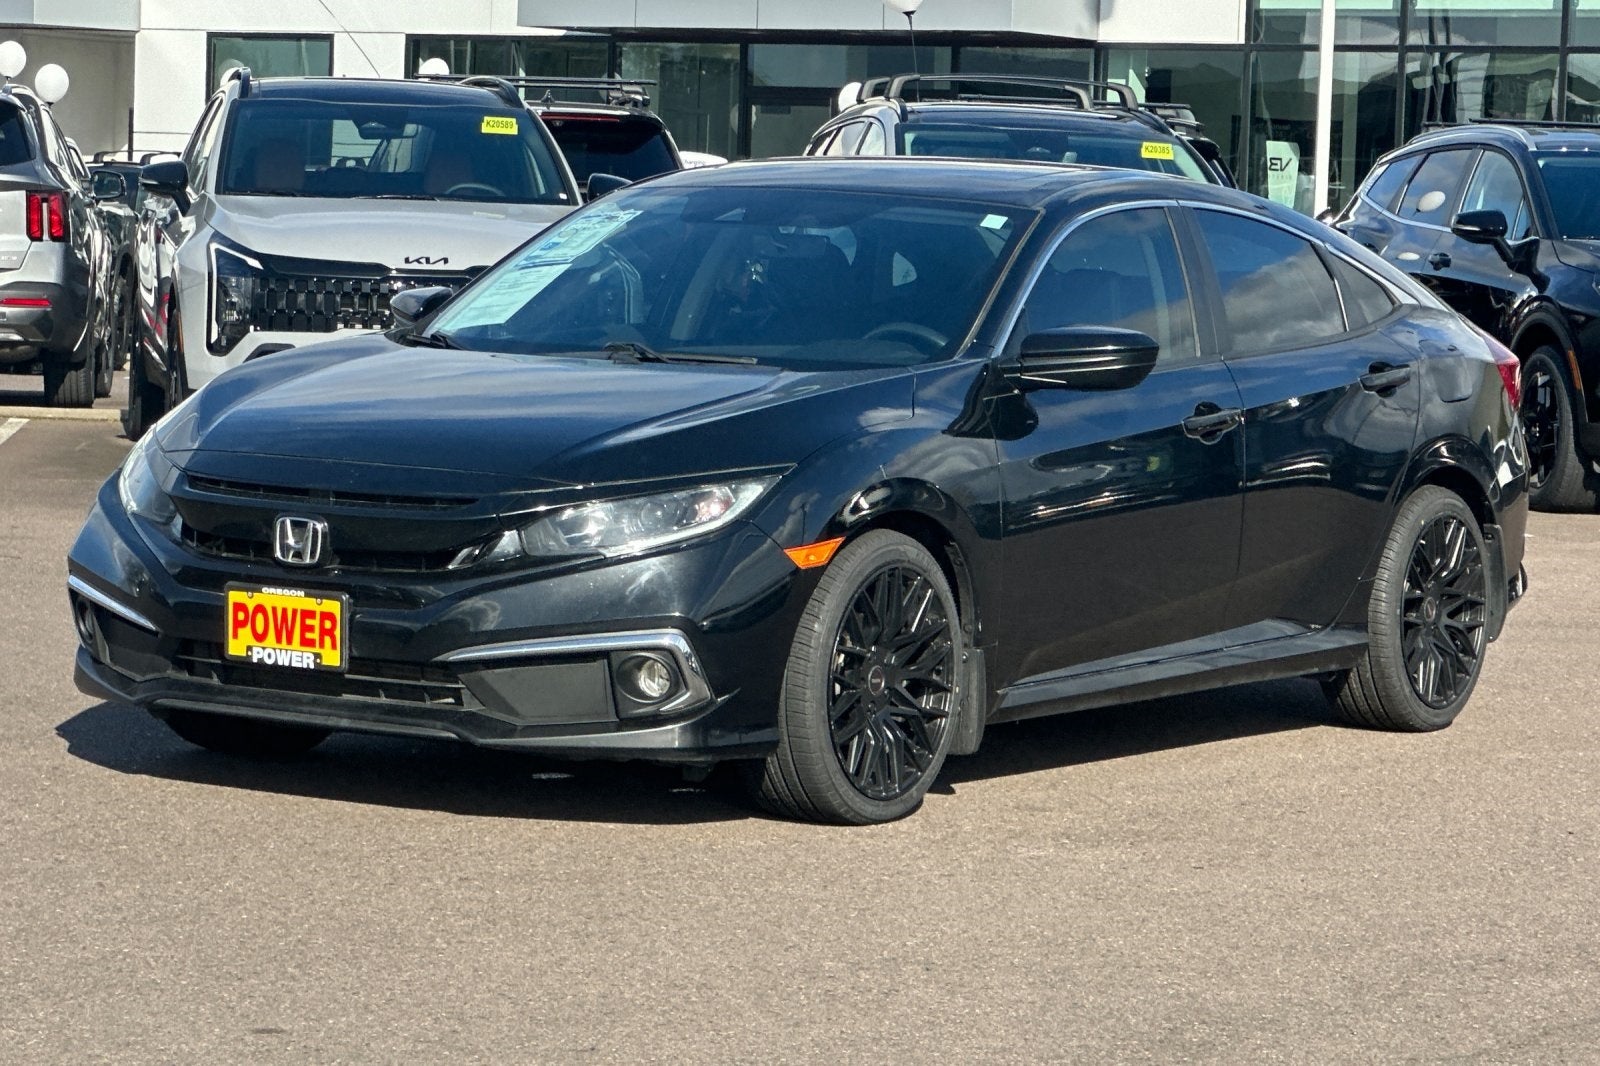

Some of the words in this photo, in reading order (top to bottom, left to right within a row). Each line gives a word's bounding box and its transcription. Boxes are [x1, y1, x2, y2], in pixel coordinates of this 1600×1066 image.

[486, 119, 514, 129] K20589
[404, 256, 449, 265] KIA
[261, 587, 305, 597] OREGON
[232, 601, 337, 650] POWER
[252, 646, 315, 669] POWER
